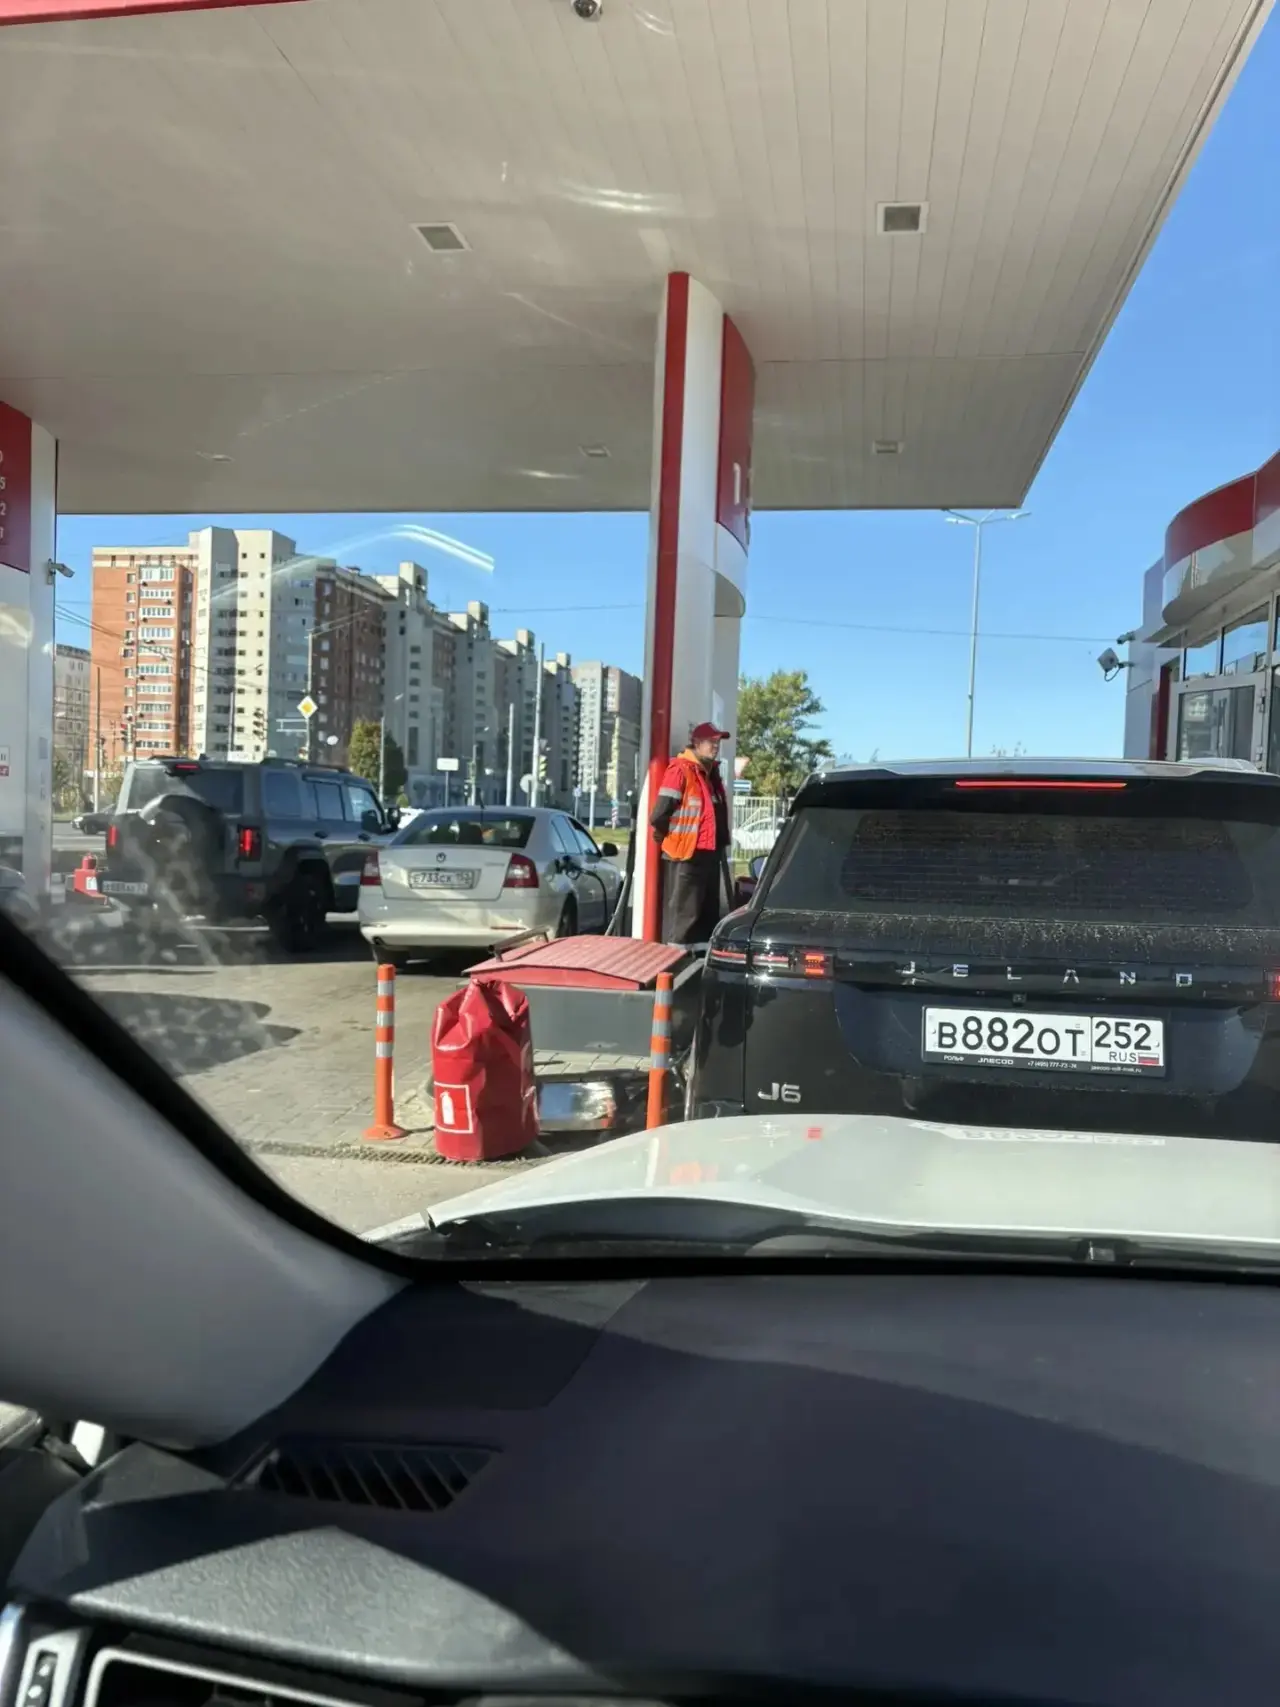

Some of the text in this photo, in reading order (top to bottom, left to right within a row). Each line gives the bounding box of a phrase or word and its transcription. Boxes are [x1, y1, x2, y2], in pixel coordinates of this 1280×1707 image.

[901, 961, 1193, 987] JELAND
[937, 1016, 1152, 1057] В882ОТ 252
[1109, 1051, 1137, 1063] RUS
[757, 1082, 802, 1103] J6
